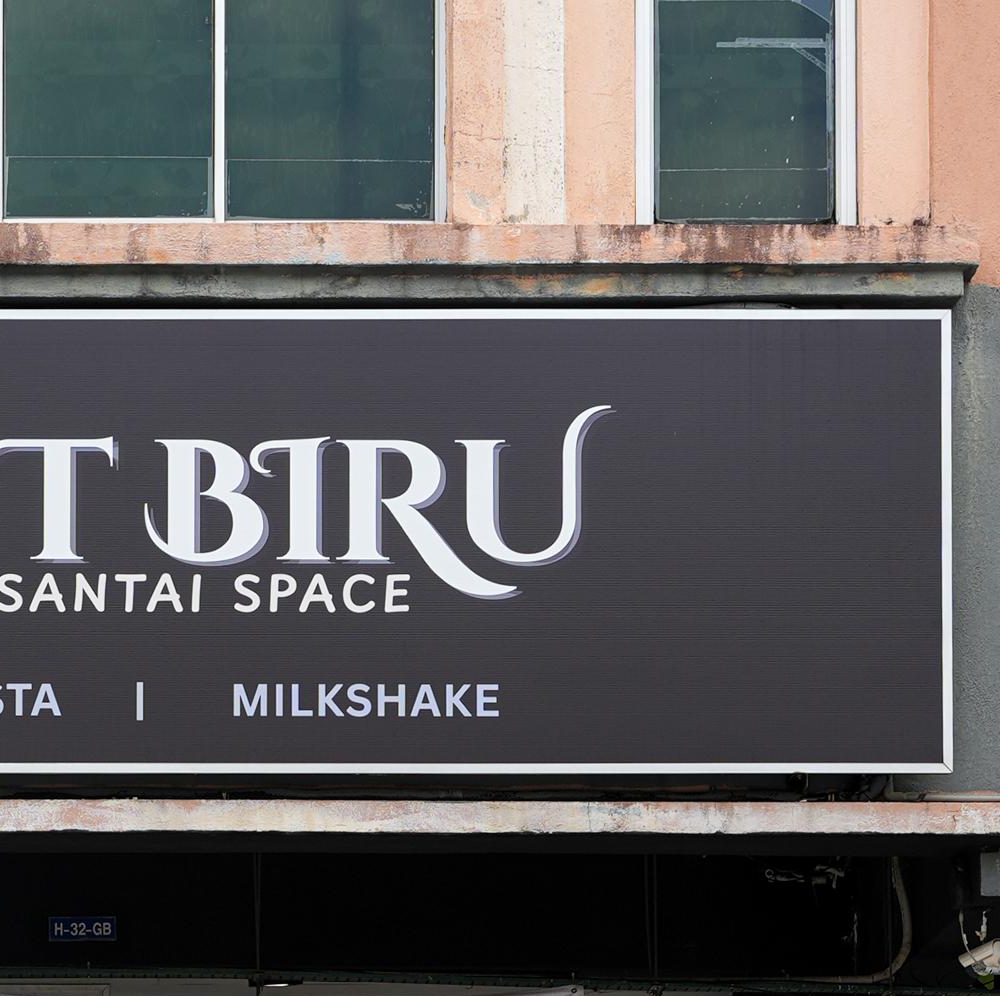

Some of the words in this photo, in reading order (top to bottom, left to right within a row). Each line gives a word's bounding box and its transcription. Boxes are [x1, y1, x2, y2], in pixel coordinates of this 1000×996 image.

[144, 405, 615, 600] BIRU
[233, 573, 411, 613] SPACE
[233, 683, 500, 718] MILKSHAKE
[54, 922, 112, 936] H-32-GB
